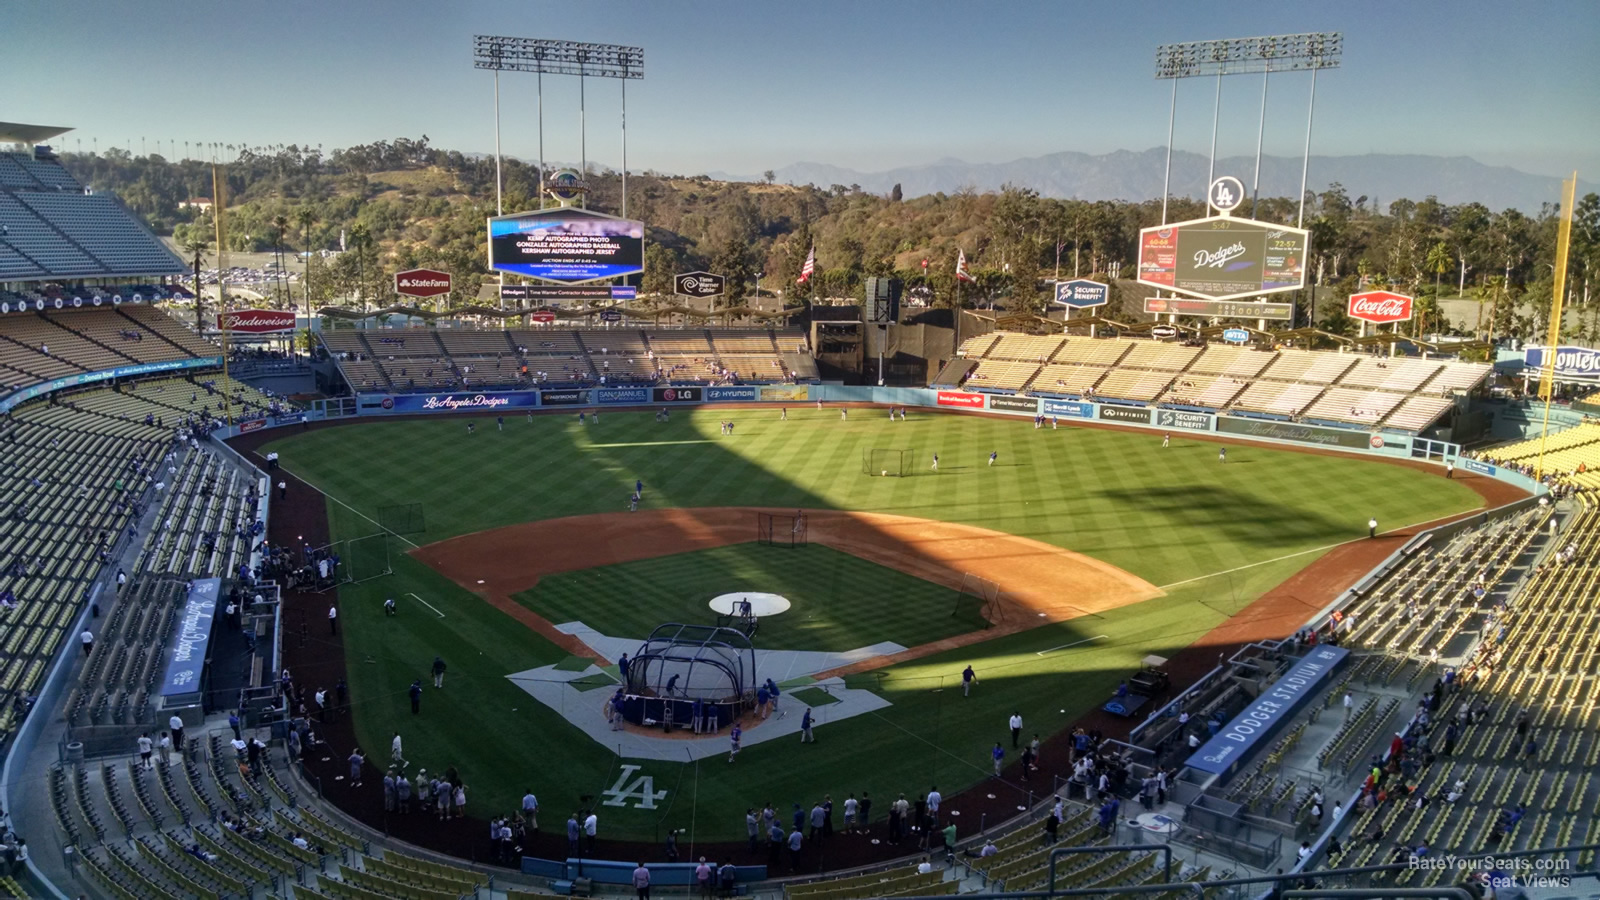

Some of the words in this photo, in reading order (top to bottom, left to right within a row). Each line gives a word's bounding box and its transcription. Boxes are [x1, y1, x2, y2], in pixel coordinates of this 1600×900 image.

[1216, 182, 1233, 205] LA
[1194, 241, 1246, 268] Dodgers
[221, 316, 294, 327] Budweiser
[423, 397, 440, 409] Los
[439, 396, 473, 410] Angeles
[473, 395, 508, 408] Dodgers
[678, 390, 692, 399] LG
[1175, 414, 1208, 422] SECURITY
[1246, 423, 1265, 434] Los
[1264, 424, 1299, 439] Angeles
[1300, 428, 1340, 444] Dodgers
[1226, 700, 1283, 742] DODGER
[1272, 662, 1323, 700] STADIUM
[602, 764, 668, 810] LA
